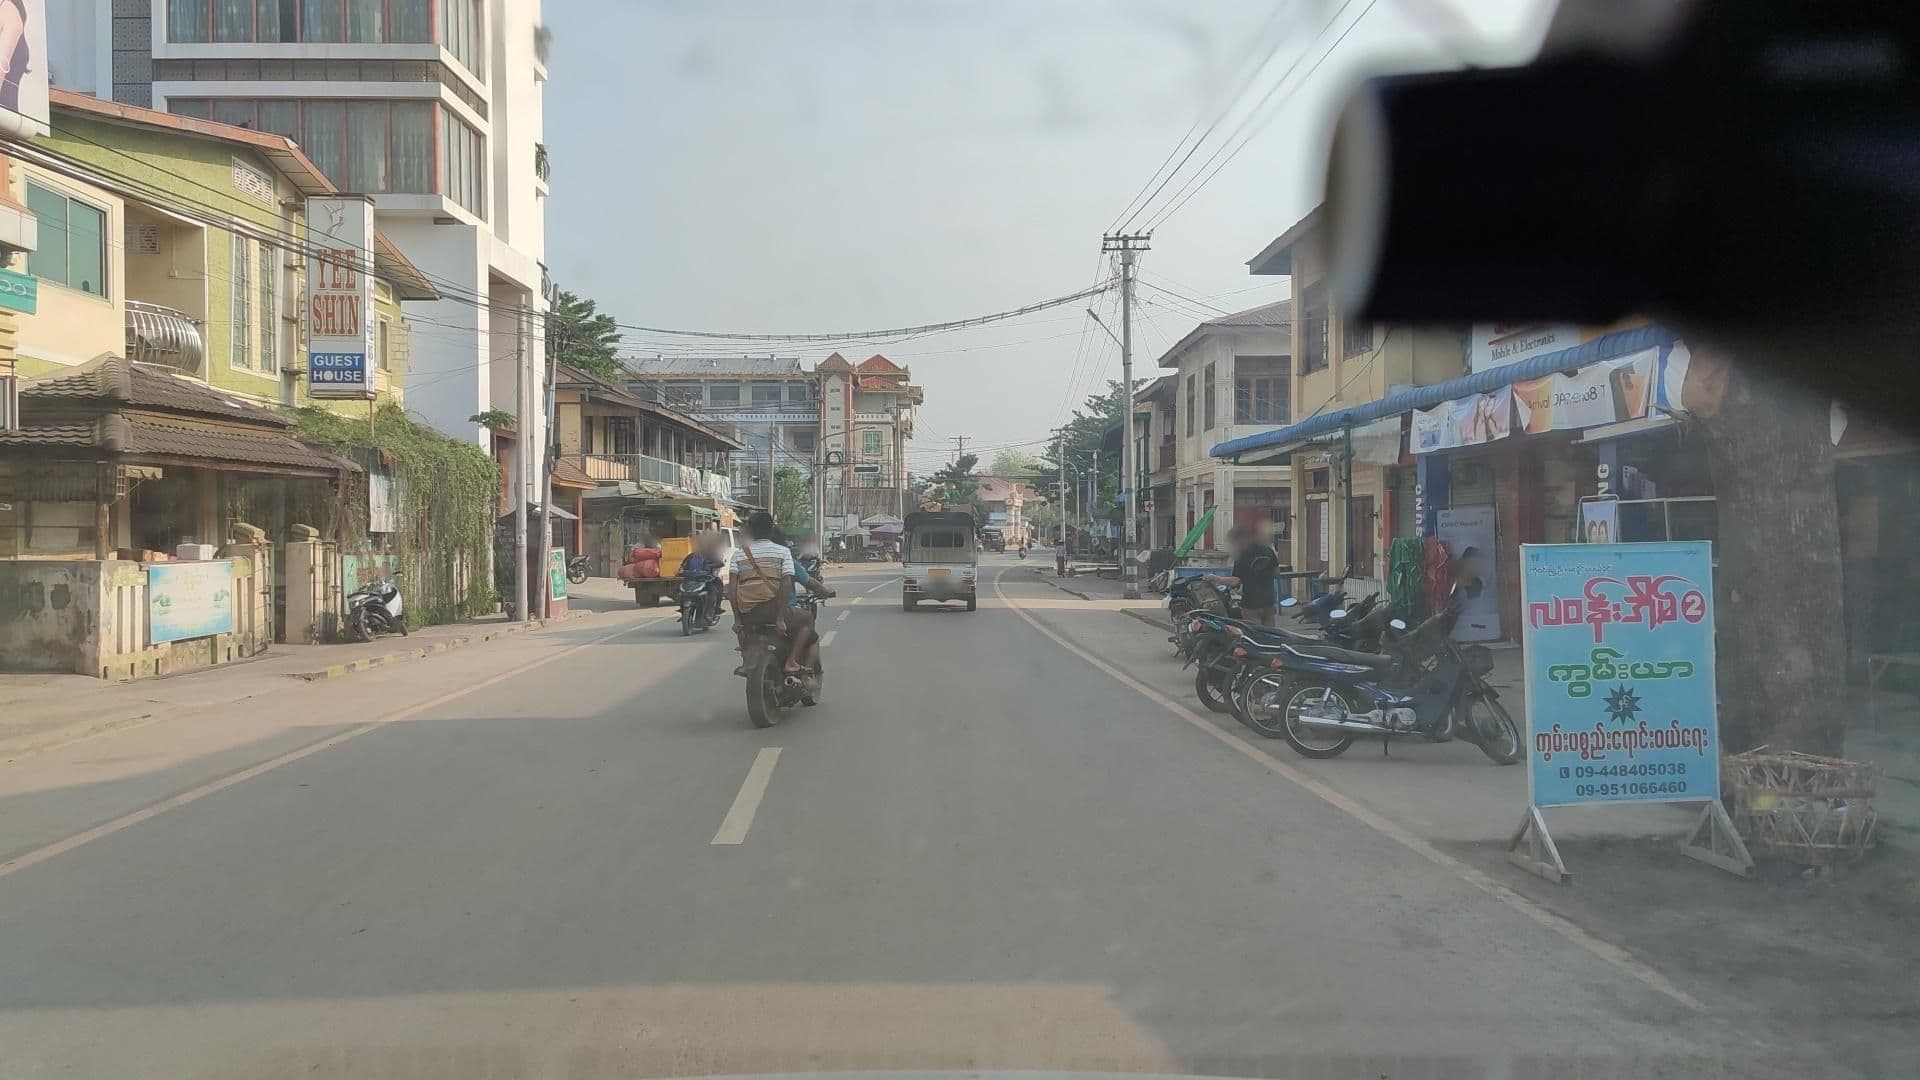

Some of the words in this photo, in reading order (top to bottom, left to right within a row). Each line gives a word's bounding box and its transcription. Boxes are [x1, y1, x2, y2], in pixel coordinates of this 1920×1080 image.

[314, 248, 357, 290] YEE
[312, 294, 361, 337] SHIN
[313, 354, 361, 367] GUEST
[313, 369, 362, 382] HOUSE
[1547, 647, 1694, 698] ကွမ်းယာ
[1575, 763, 1686, 779] 09-448405038
[1575, 781, 1687, 797] 09-951066460
